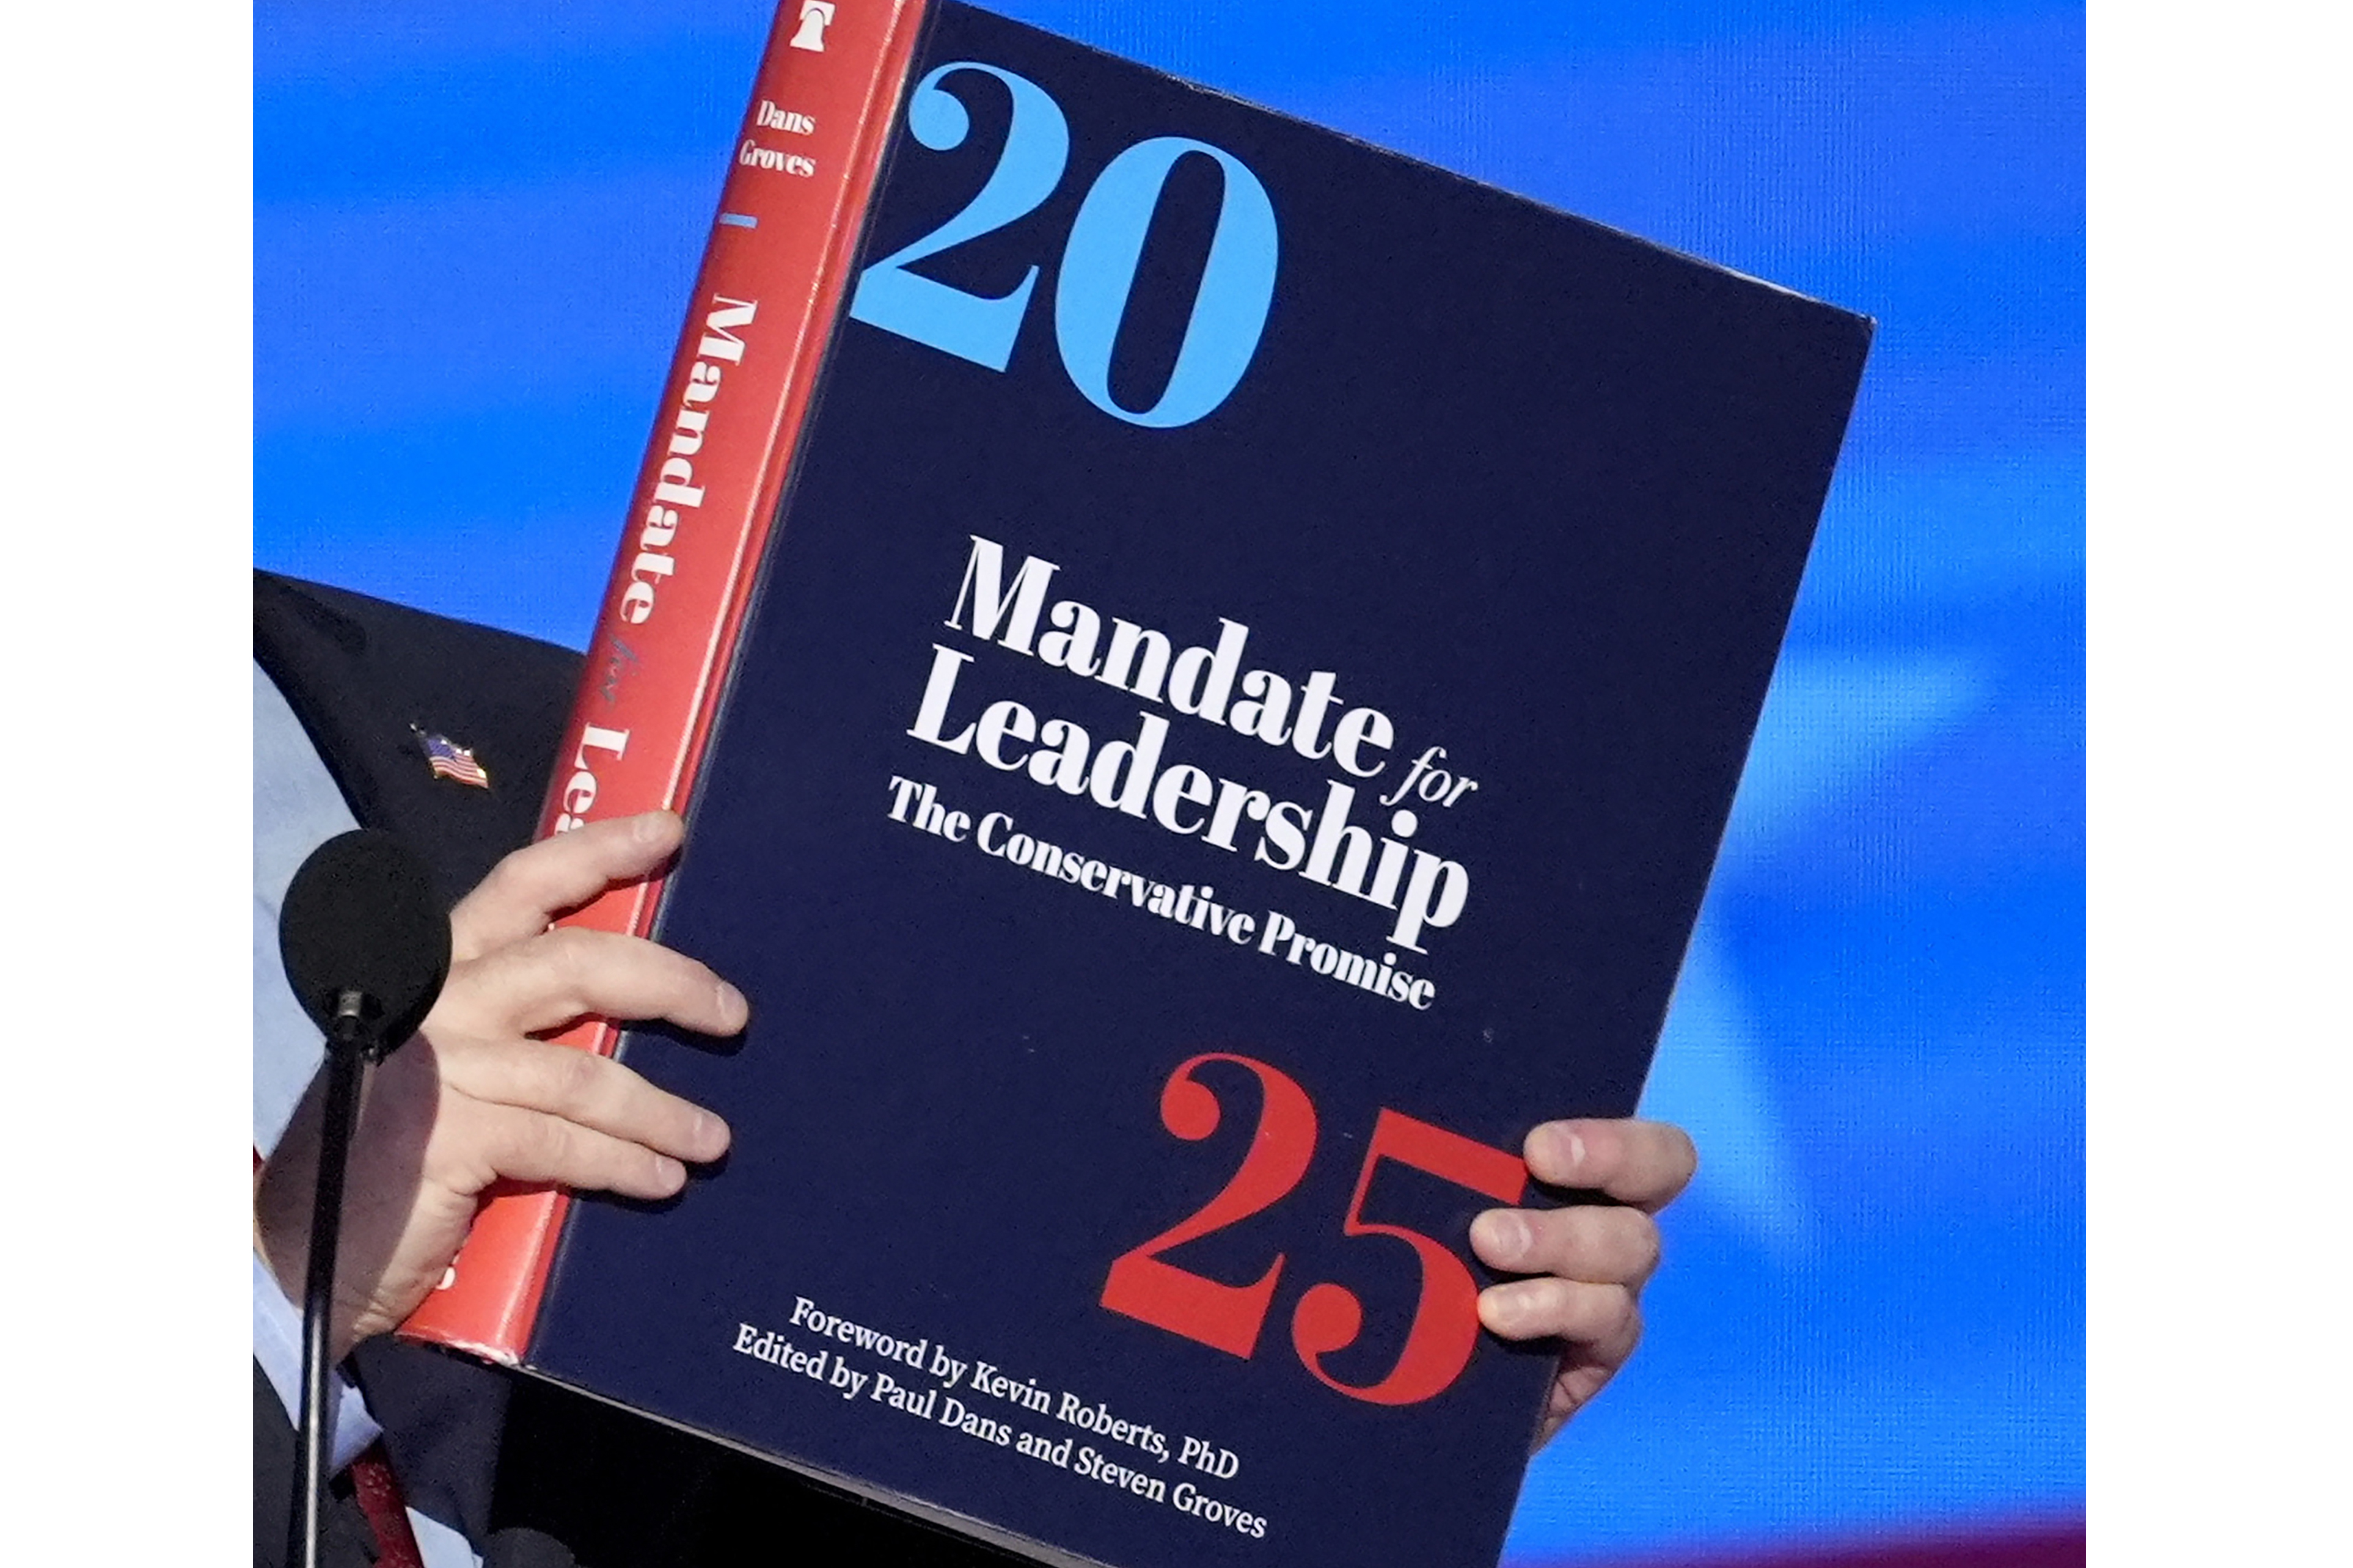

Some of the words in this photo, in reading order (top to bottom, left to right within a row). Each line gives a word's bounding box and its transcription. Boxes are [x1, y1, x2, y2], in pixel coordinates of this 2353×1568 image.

[739, 139, 816, 178] Groves
[756, 100, 816, 136] Dans
[849, 62, 1279, 428] 20
[621, 293, 759, 624] Mandate
[943, 534, 1394, 778] Mandate
[1379, 746, 1479, 808] for
[887, 775, 972, 843] The
[976, 811, 1256, 945] Conservative
[1257, 910, 1436, 1010] Promise
[906, 643, 1469, 955] Leadership
[1100, 1052, 1529, 1406] 25
[732, 1322, 829, 1381] Edited
[829, 1355, 869, 1400] by
[869, 1371, 937, 1420] Paul
[938, 1396, 1012, 1446] Dans
[1015, 1432, 1074, 1469] and
[1074, 1446, 1166, 1503] Steven
[1172, 1482, 1268, 1539] Groves
[789, 1296, 928, 1369] Foreword
[928, 1344, 968, 1389] by
[970, 1360, 1052, 1415] Kevin
[1055, 1391, 1170, 1464] Roberts,
[1177, 1435, 1239, 1479] PhD
